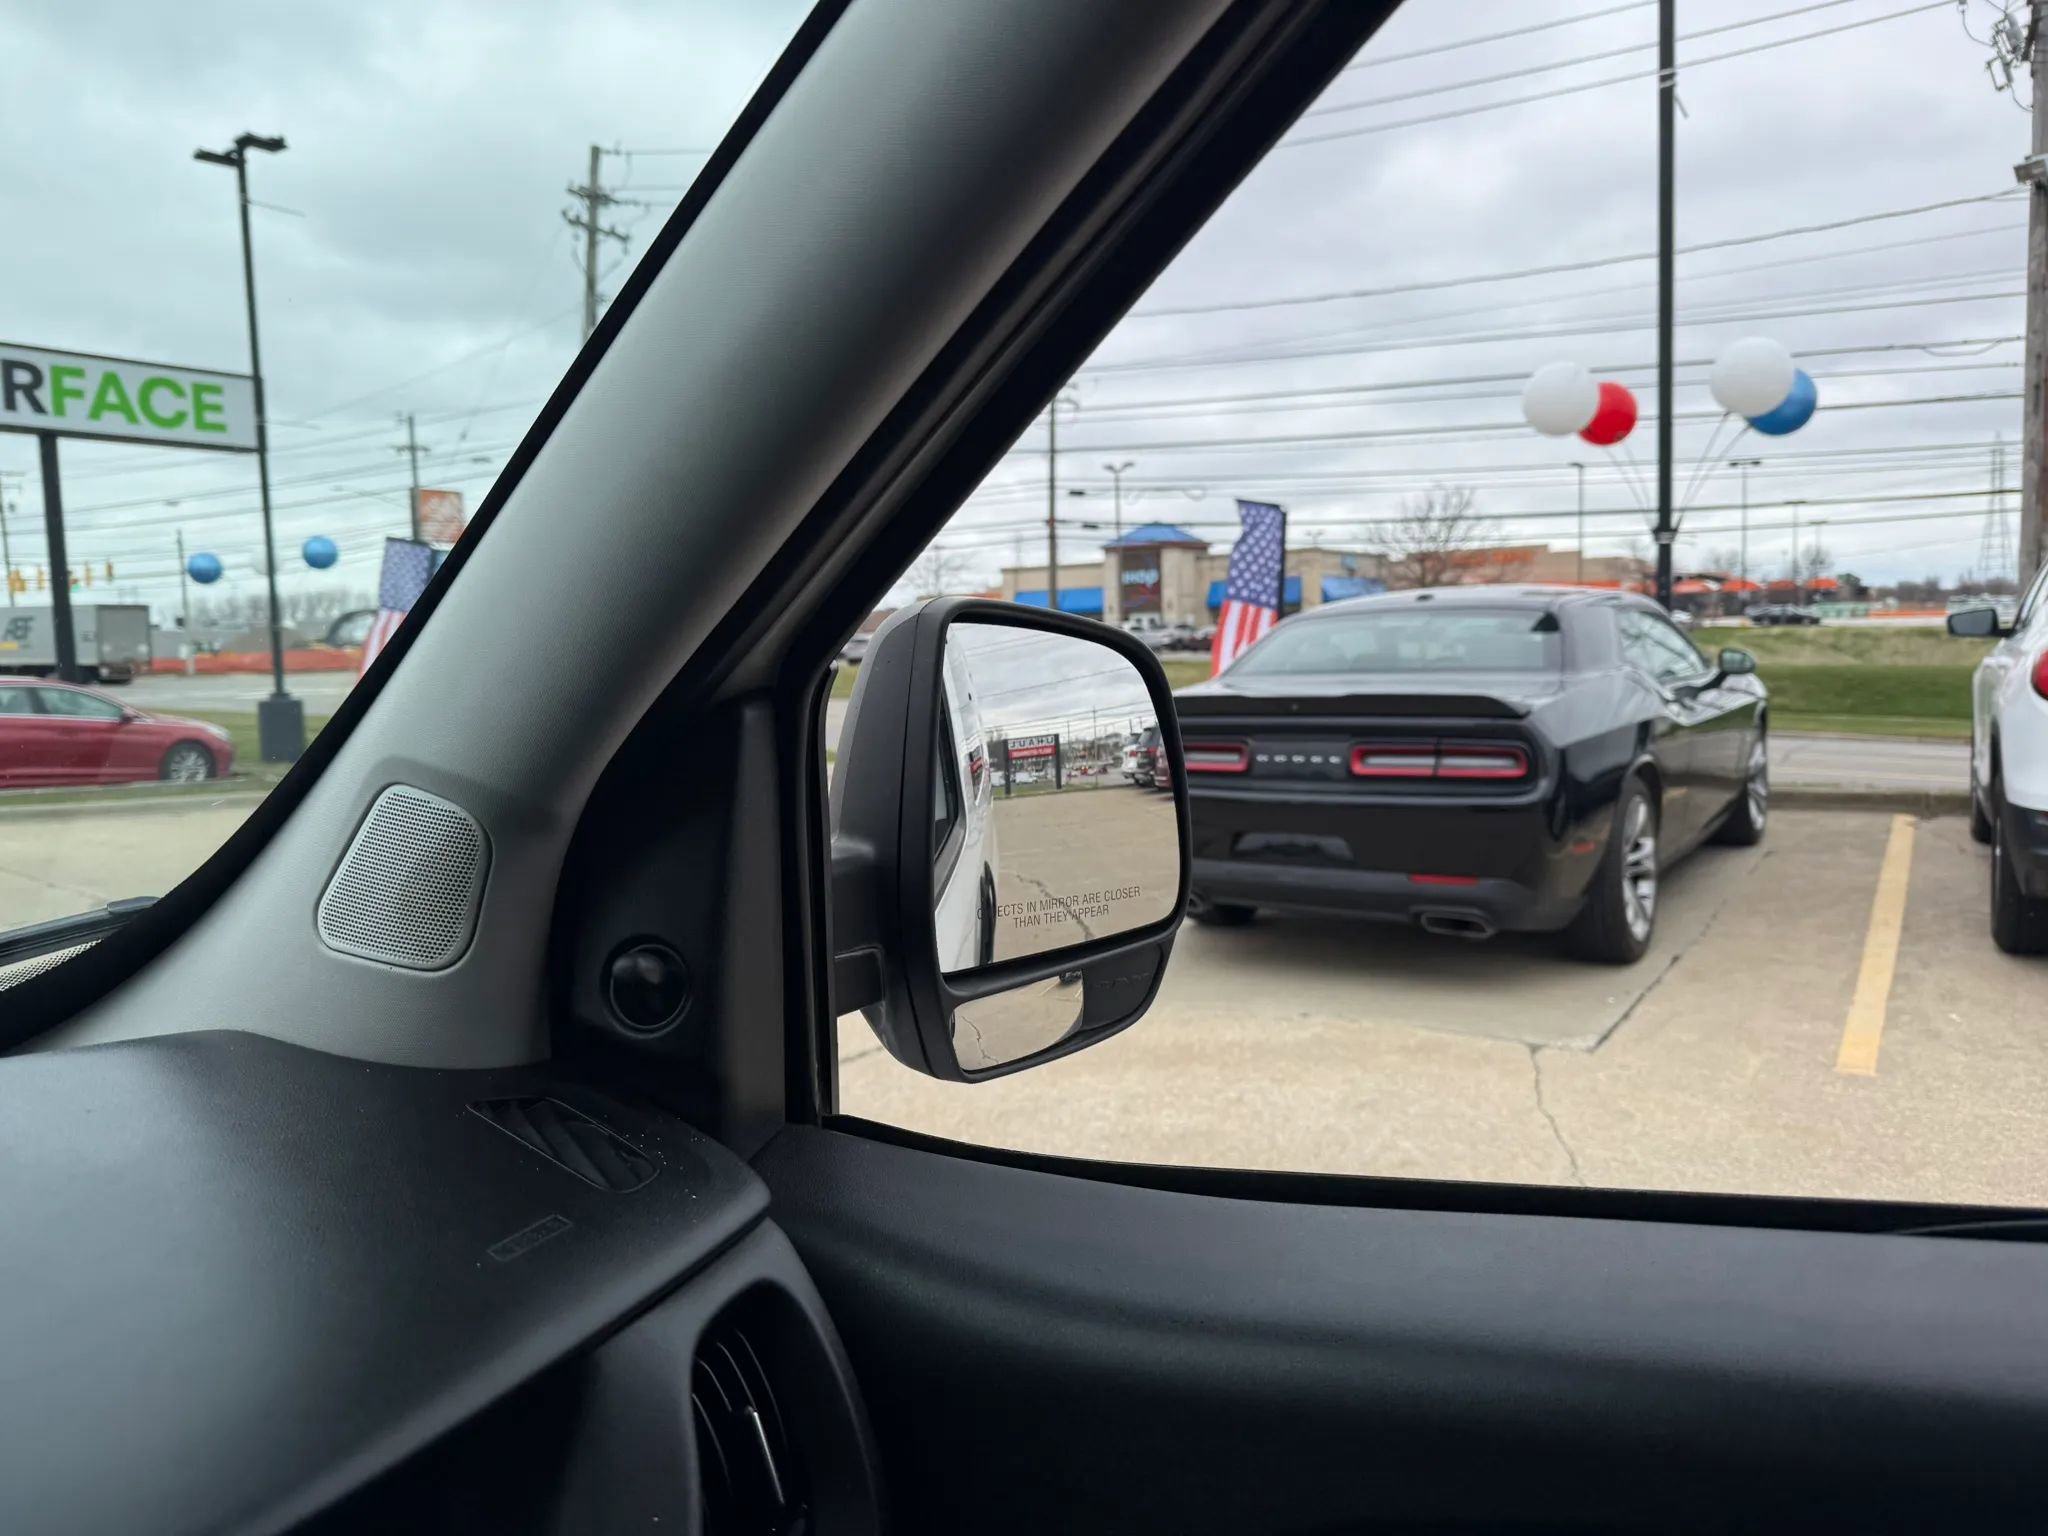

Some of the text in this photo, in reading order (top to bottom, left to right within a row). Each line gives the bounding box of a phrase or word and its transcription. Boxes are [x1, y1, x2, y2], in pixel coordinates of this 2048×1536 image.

[1, 358, 227, 433] RFACE
[977, 886, 1141, 920] OECTS IN MIRROR ARE CLOSER
[1013, 904, 1109, 929] THAN THEY APPEAR
